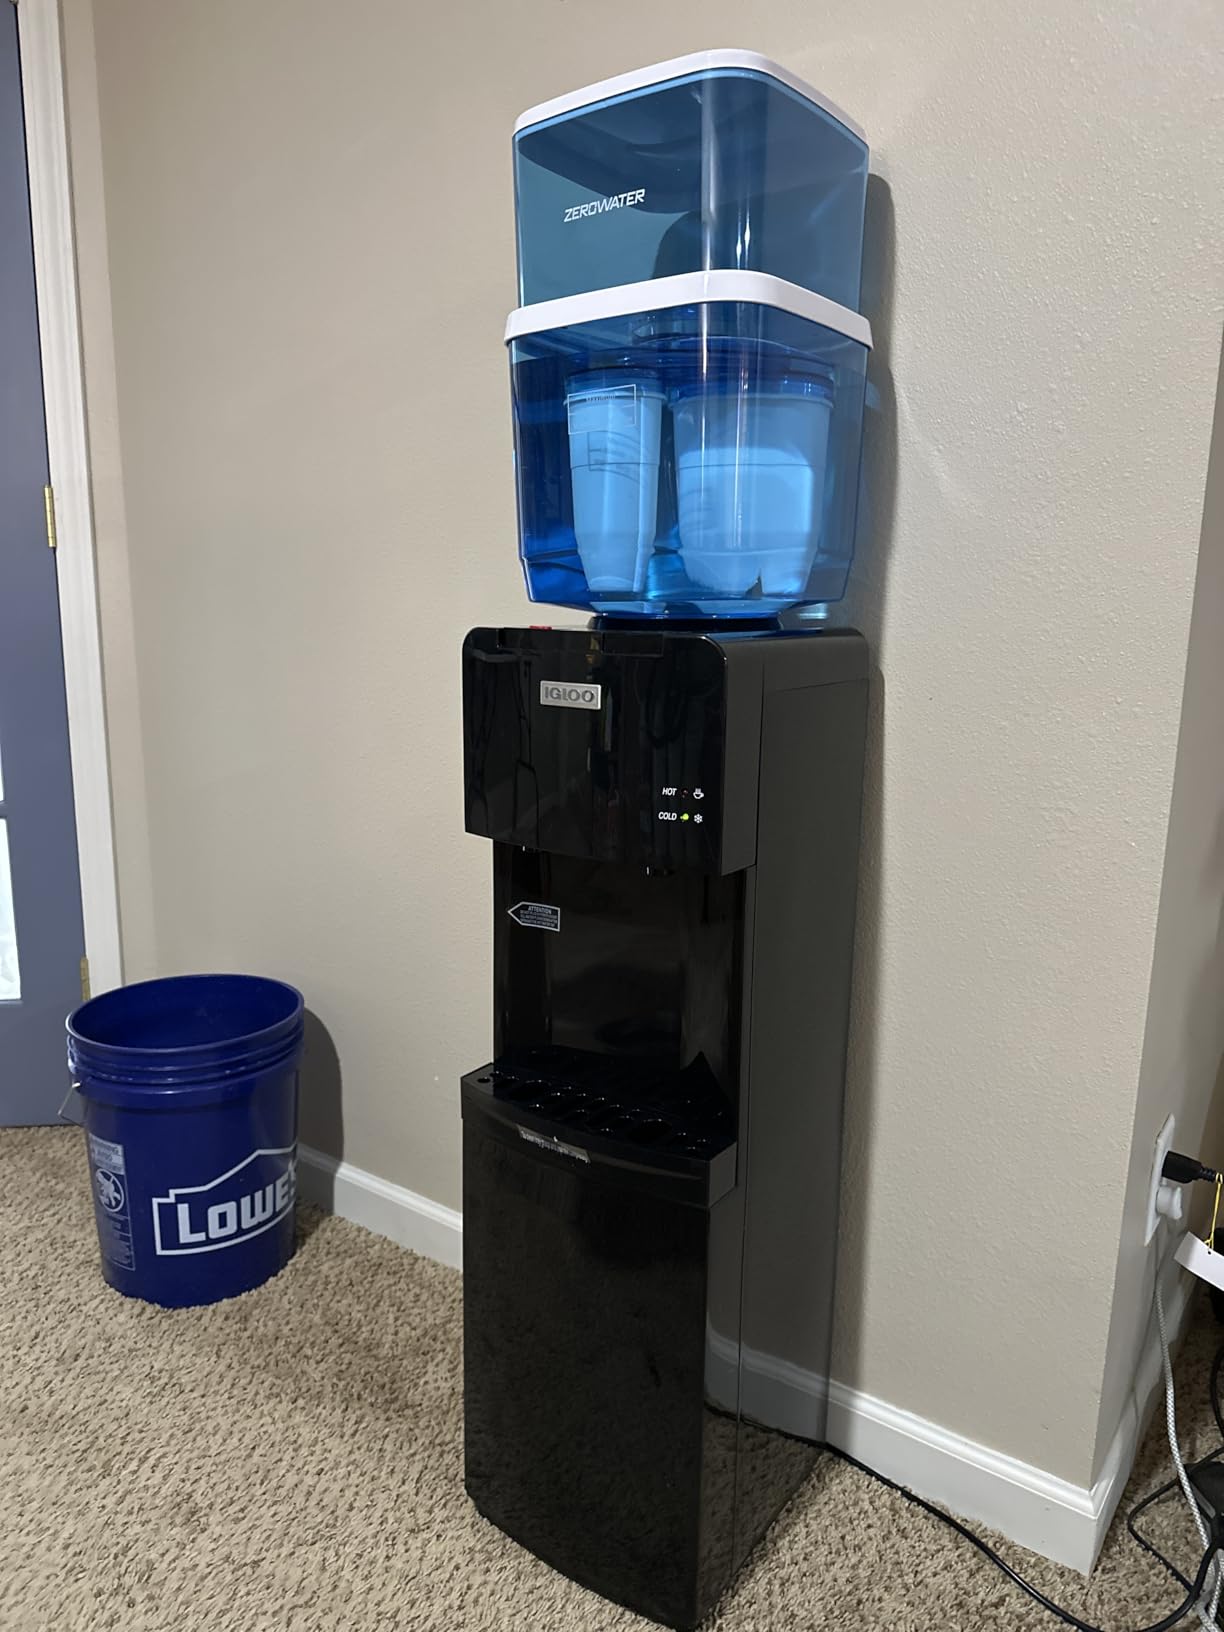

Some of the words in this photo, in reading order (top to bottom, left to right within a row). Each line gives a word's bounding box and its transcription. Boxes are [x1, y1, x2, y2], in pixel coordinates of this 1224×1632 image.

[564, 189, 645, 222] ZEROWATER
[545, 686, 595, 702] IGLOO
[662, 787, 677, 796] HOT
[658, 811, 677, 821] COLD
